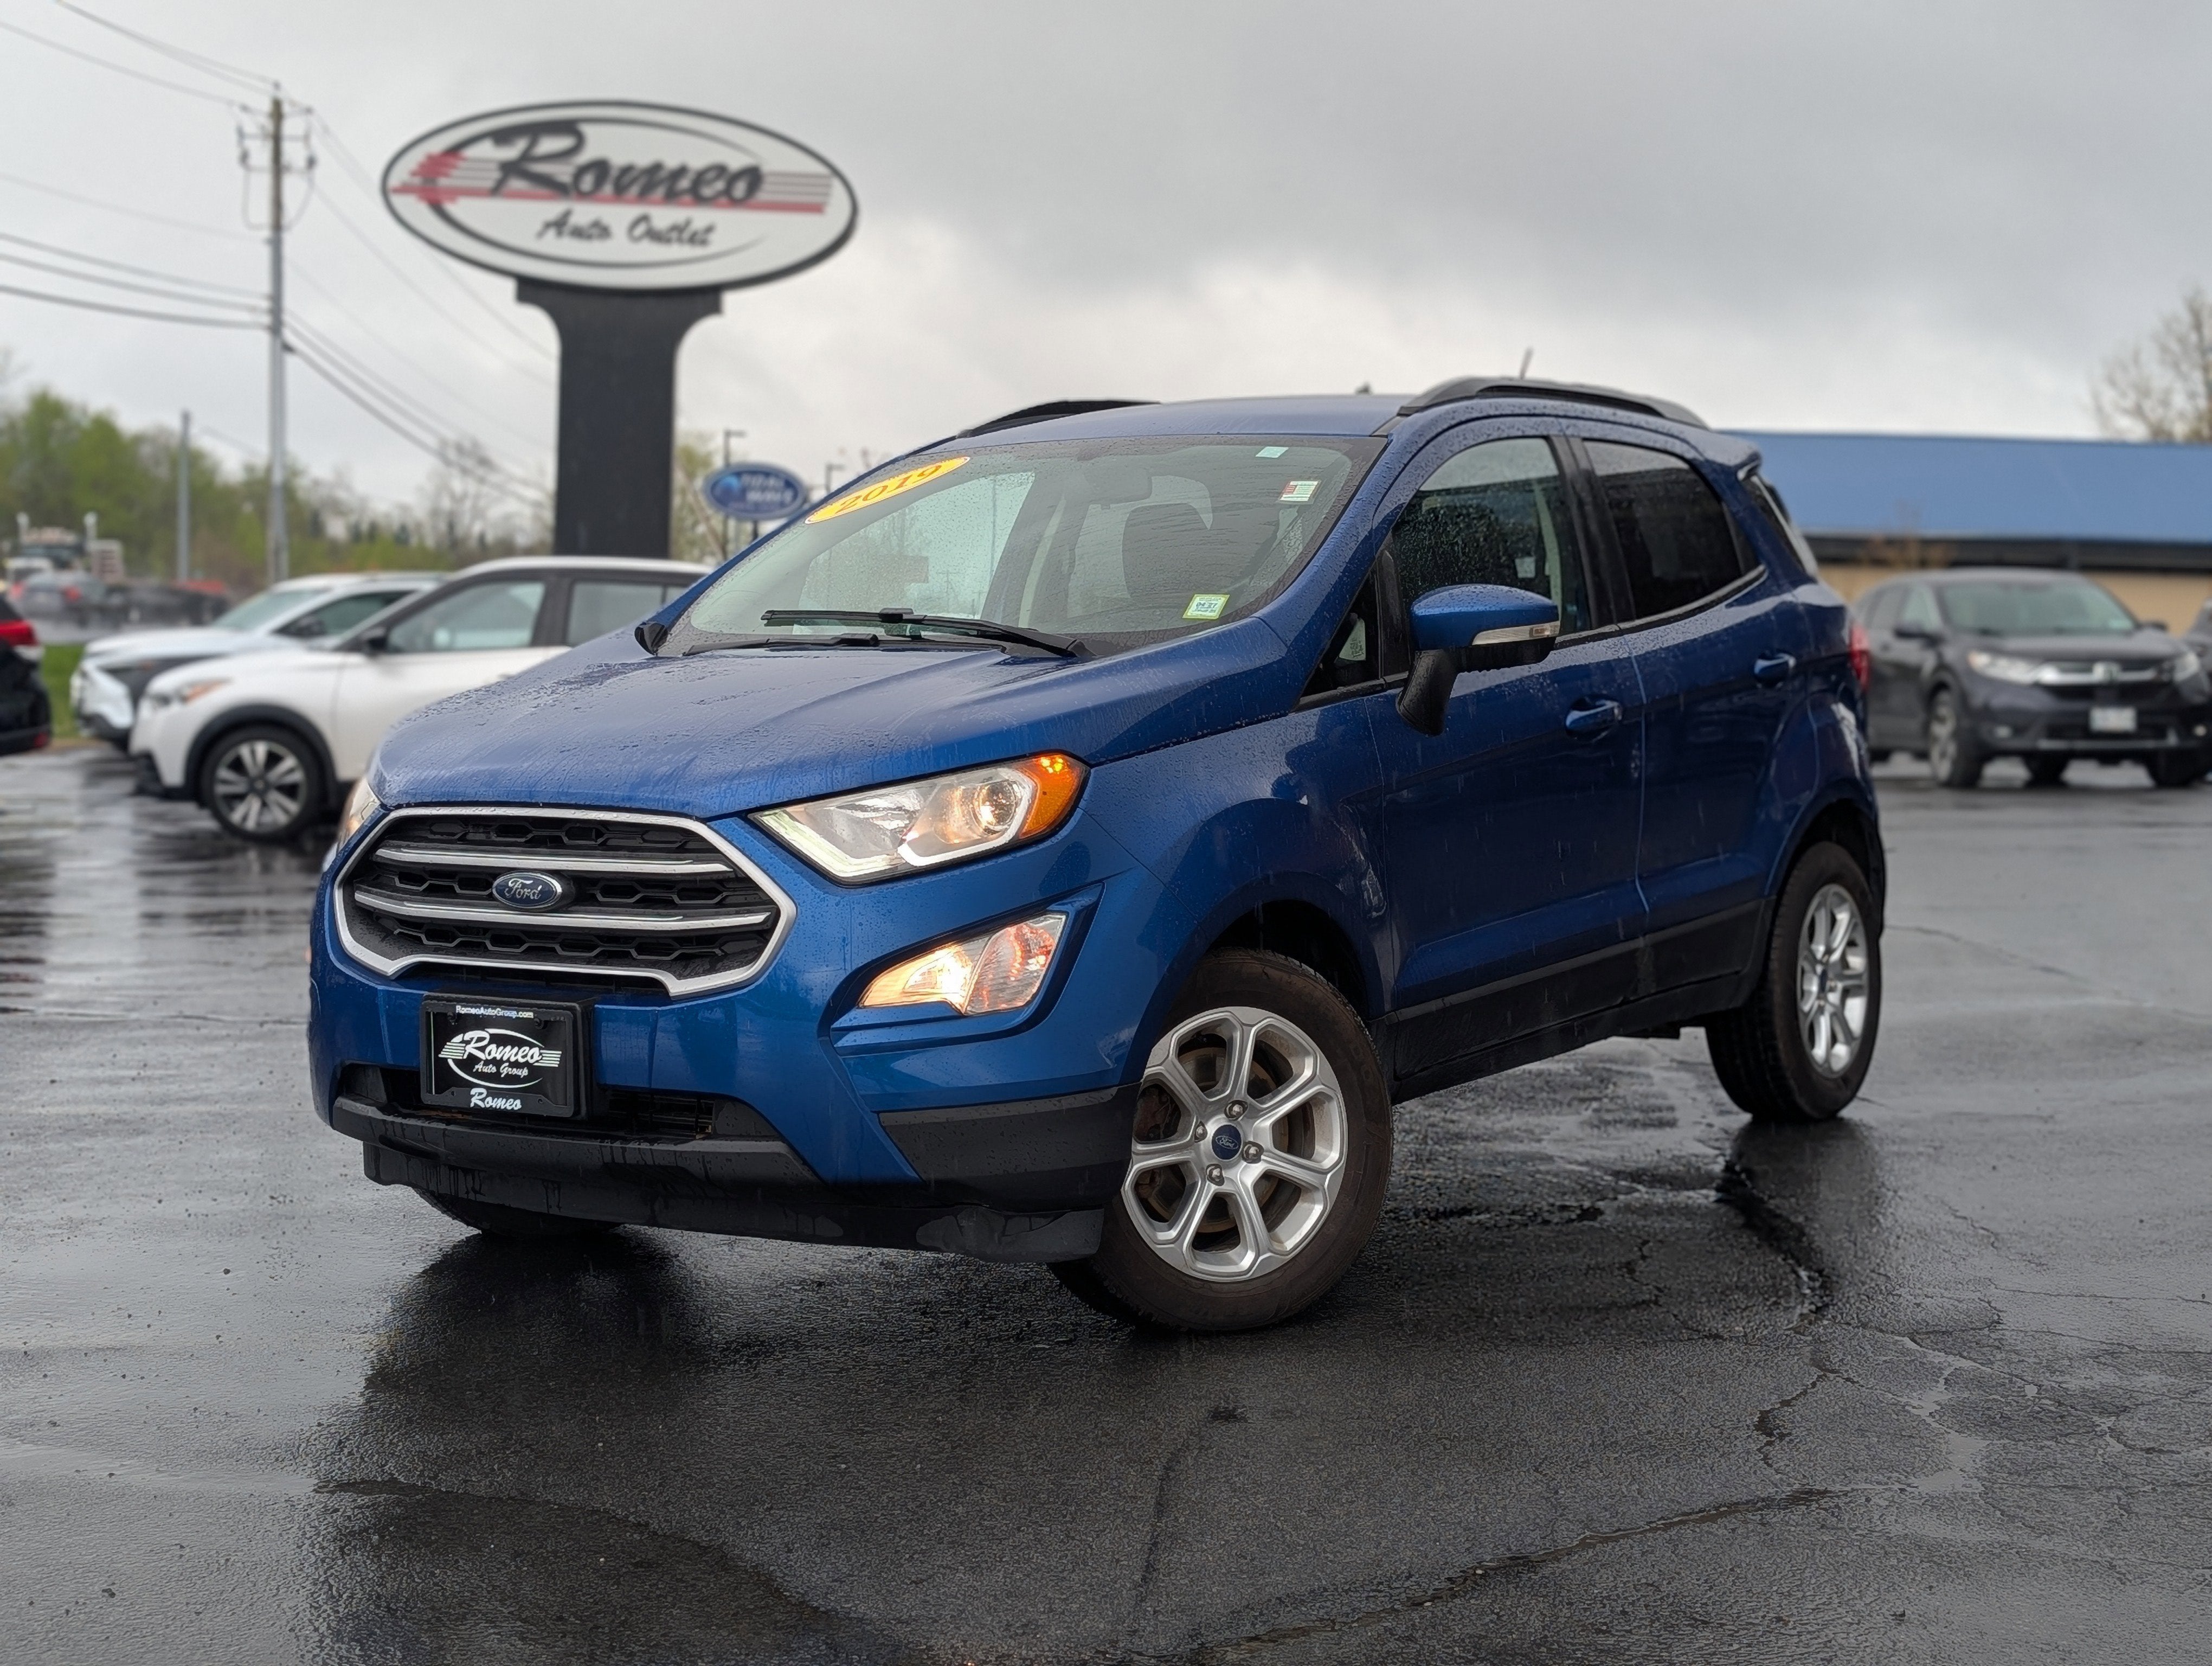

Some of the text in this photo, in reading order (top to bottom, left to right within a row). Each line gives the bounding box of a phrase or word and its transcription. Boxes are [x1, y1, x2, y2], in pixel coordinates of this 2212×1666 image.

[490, 120, 764, 205] Romeo
[536, 208, 716, 247] Auto Outlet
[834, 464, 942, 515] 2019
[504, 878, 542, 900] Ford
[455, 1005, 533, 1018] RomeoAutoGroup.com
[463, 1030, 542, 1063] Romeo
[473, 1061, 528, 1078] Auto Group
[470, 1087, 522, 1110] Romeo
